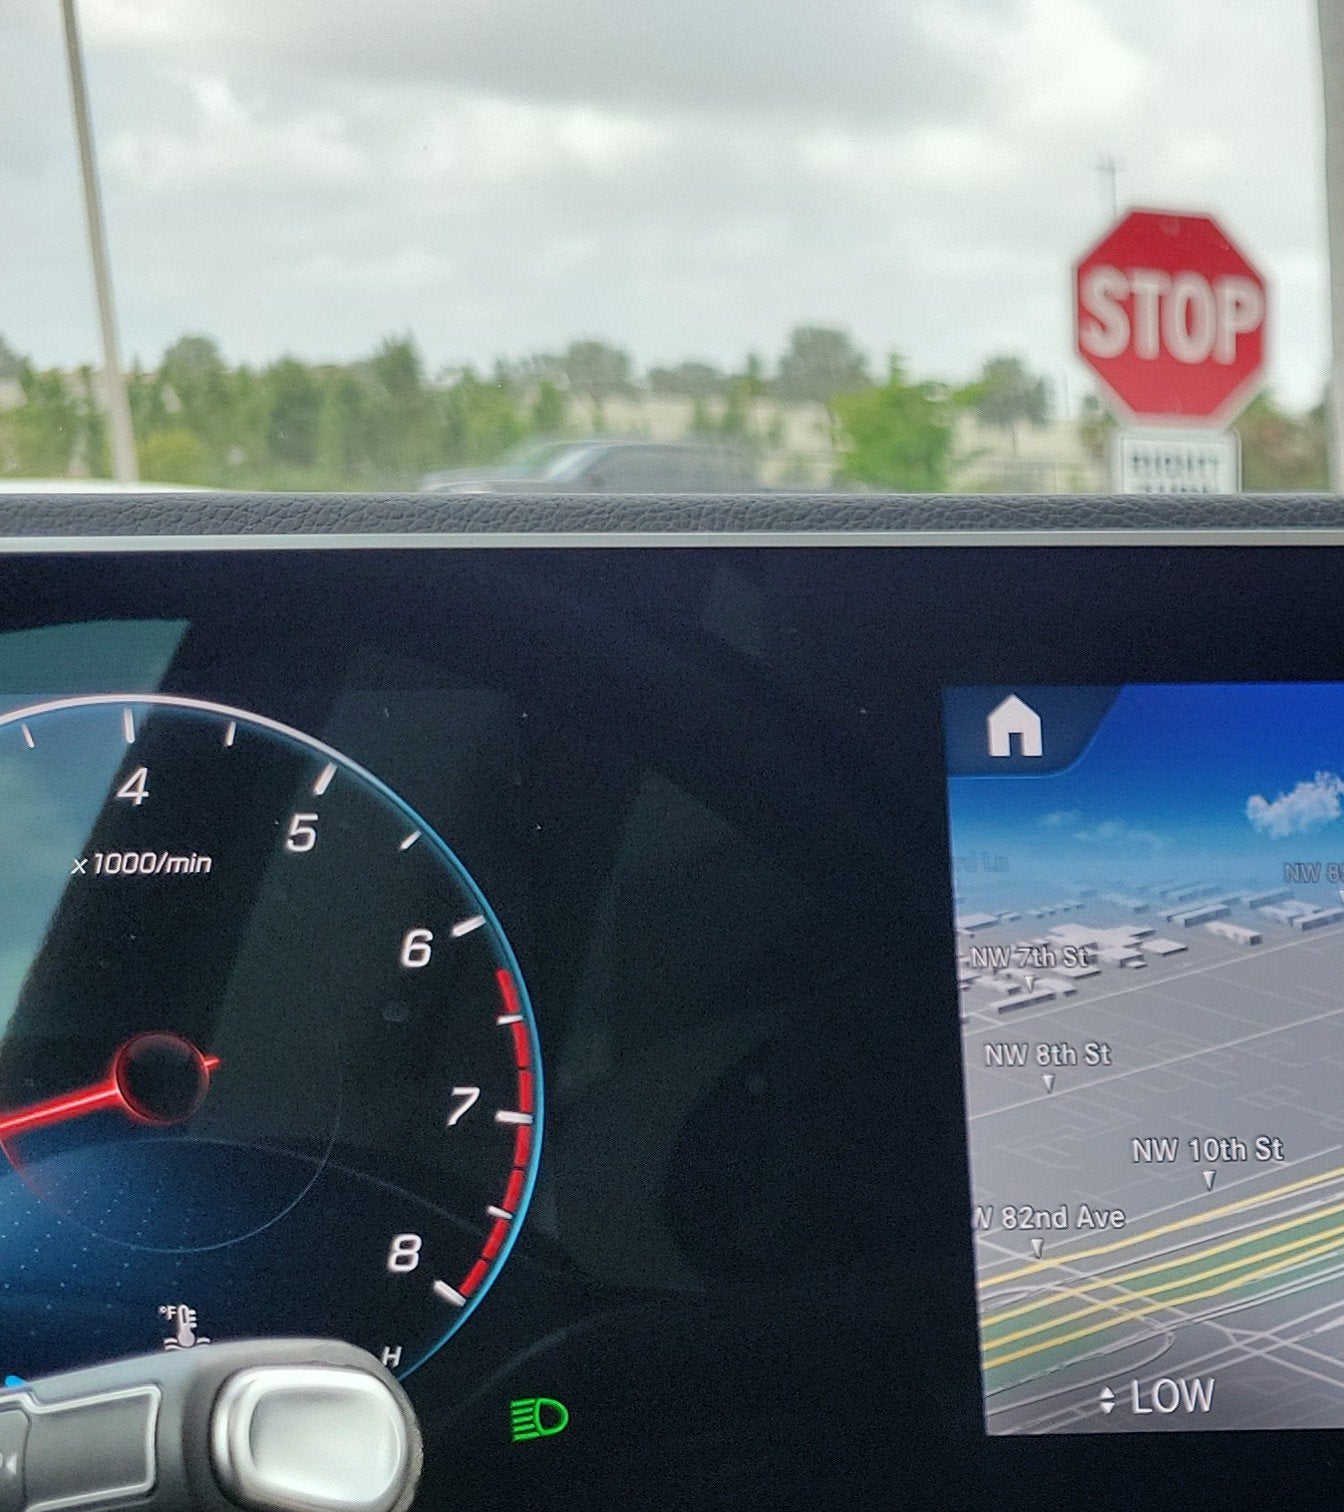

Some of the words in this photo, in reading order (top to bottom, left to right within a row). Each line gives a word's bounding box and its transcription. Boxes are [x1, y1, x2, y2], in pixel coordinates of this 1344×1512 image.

[1080, 265, 1266, 365] STOP
[116, 767, 149, 805] 4
[286, 813, 318, 852] 5
[1284, 863, 1321, 882] NW
[402, 929, 433, 968] 6
[971, 946, 1014, 968] NW
[1017, 946, 1056, 967] 7th
[1062, 945, 1089, 967] St
[985, 1044, 1026, 1066] NW
[1037, 1043, 1077, 1065] 8th
[1085, 1042, 1112, 1065] St
[446, 1087, 481, 1127] 7
[1132, 1139, 1178, 1162] NW
[1190, 1137, 1247, 1162] 10th
[1255, 1136, 1285, 1160] St
[1002, 1206, 1068, 1230] 82nd
[1077, 1205, 1126, 1229] Ave
[388, 1234, 421, 1272] 8
[381, 1346, 403, 1367] H
[1131, 1378, 1215, 1415] LOW
